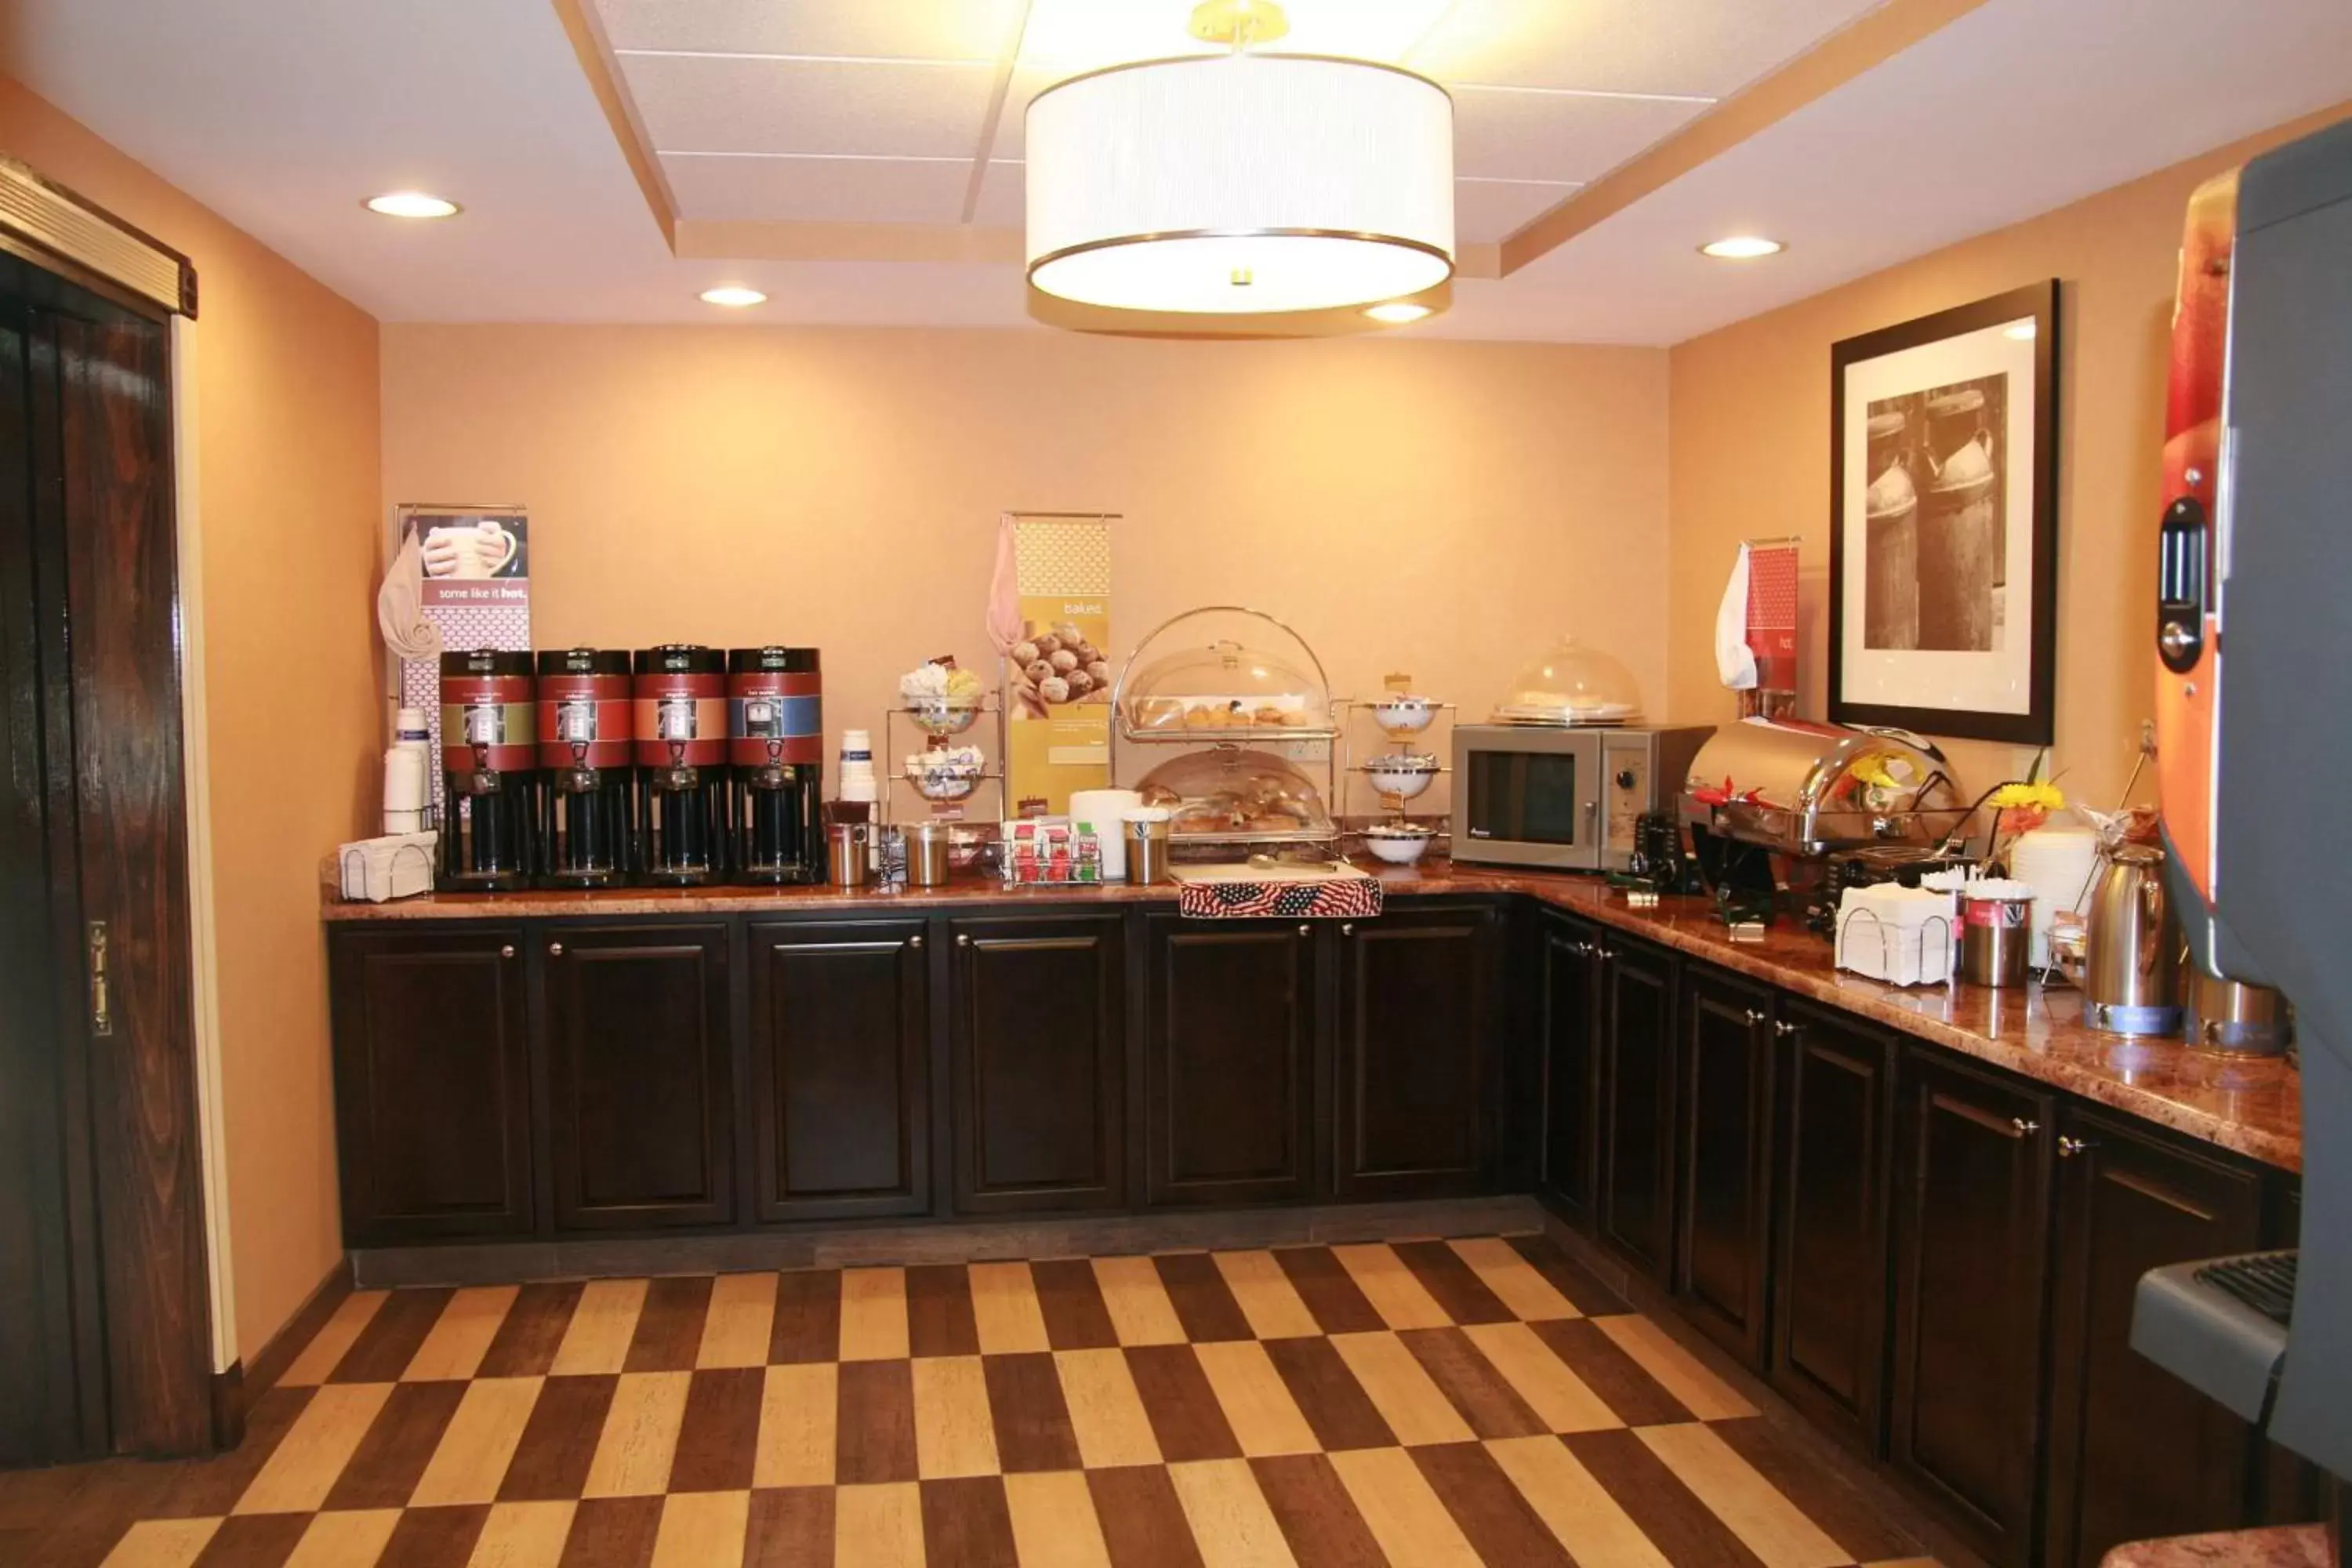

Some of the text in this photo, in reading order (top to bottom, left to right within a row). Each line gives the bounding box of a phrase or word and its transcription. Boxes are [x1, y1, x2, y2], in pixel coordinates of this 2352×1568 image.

[439, 587, 528, 599] some like it hot.
